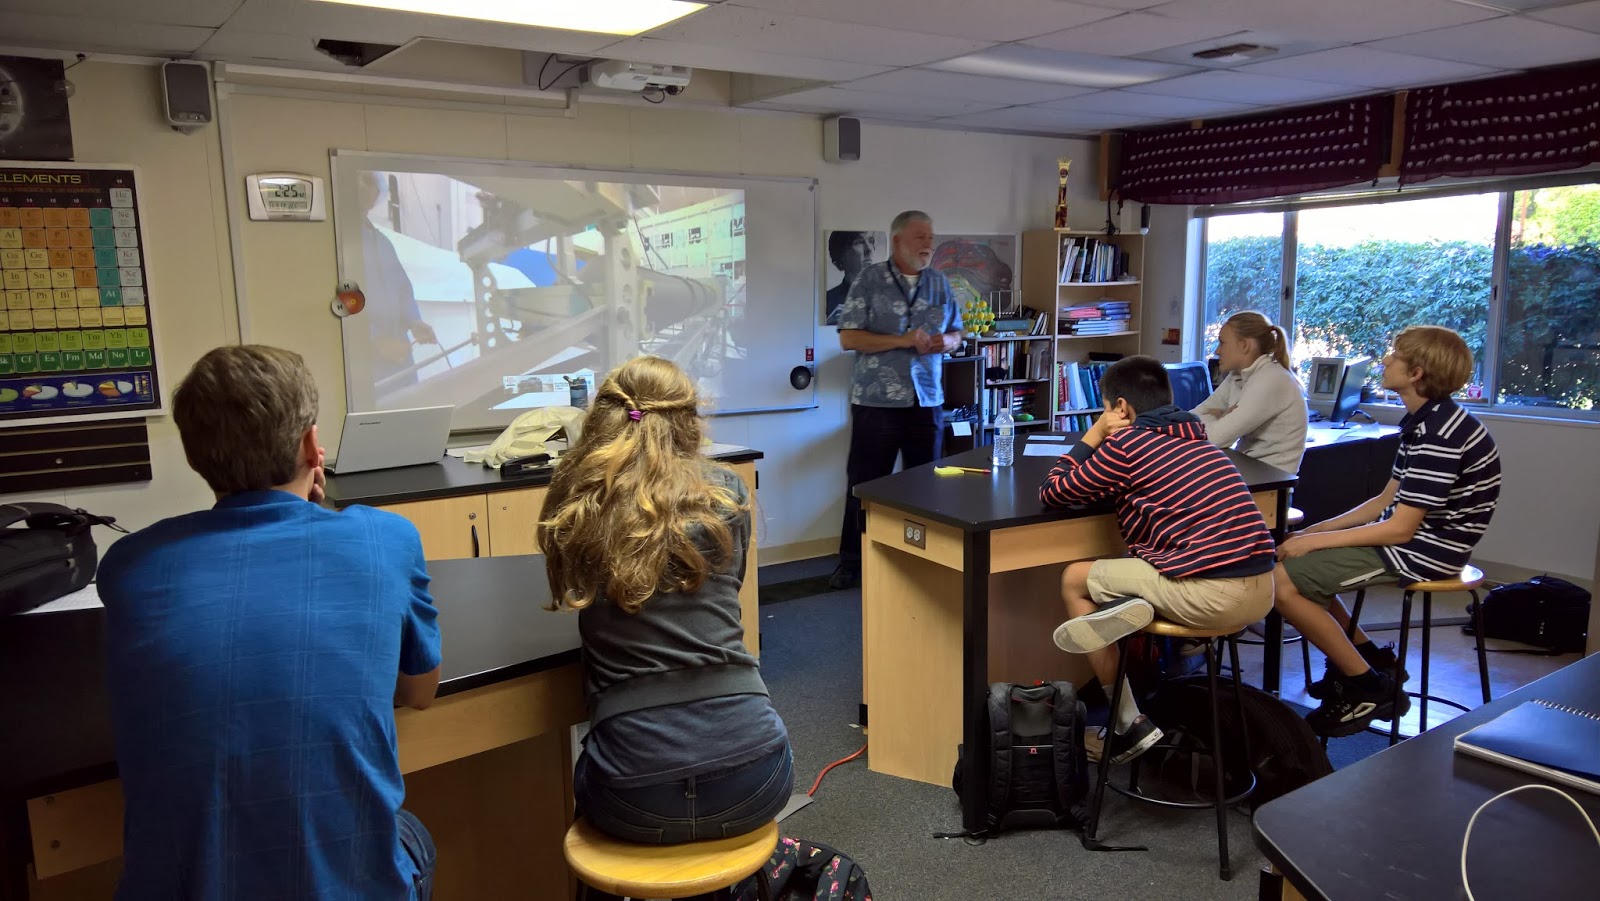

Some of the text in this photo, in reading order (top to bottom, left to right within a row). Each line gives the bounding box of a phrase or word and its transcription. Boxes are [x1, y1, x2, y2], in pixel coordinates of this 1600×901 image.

[274, 184, 298, 198] 2:25
[10, 272, 20, 280] In
[33, 271, 45, 279] Sn
[17, 335, 29, 345] Dy
[20, 355, 32, 363] Cf
[44, 354, 56, 362] Es
[66, 353, 80, 362] Fm
[88, 351, 103, 360] Md
[111, 351, 125, 359] No
[135, 350, 146, 358] Lr
